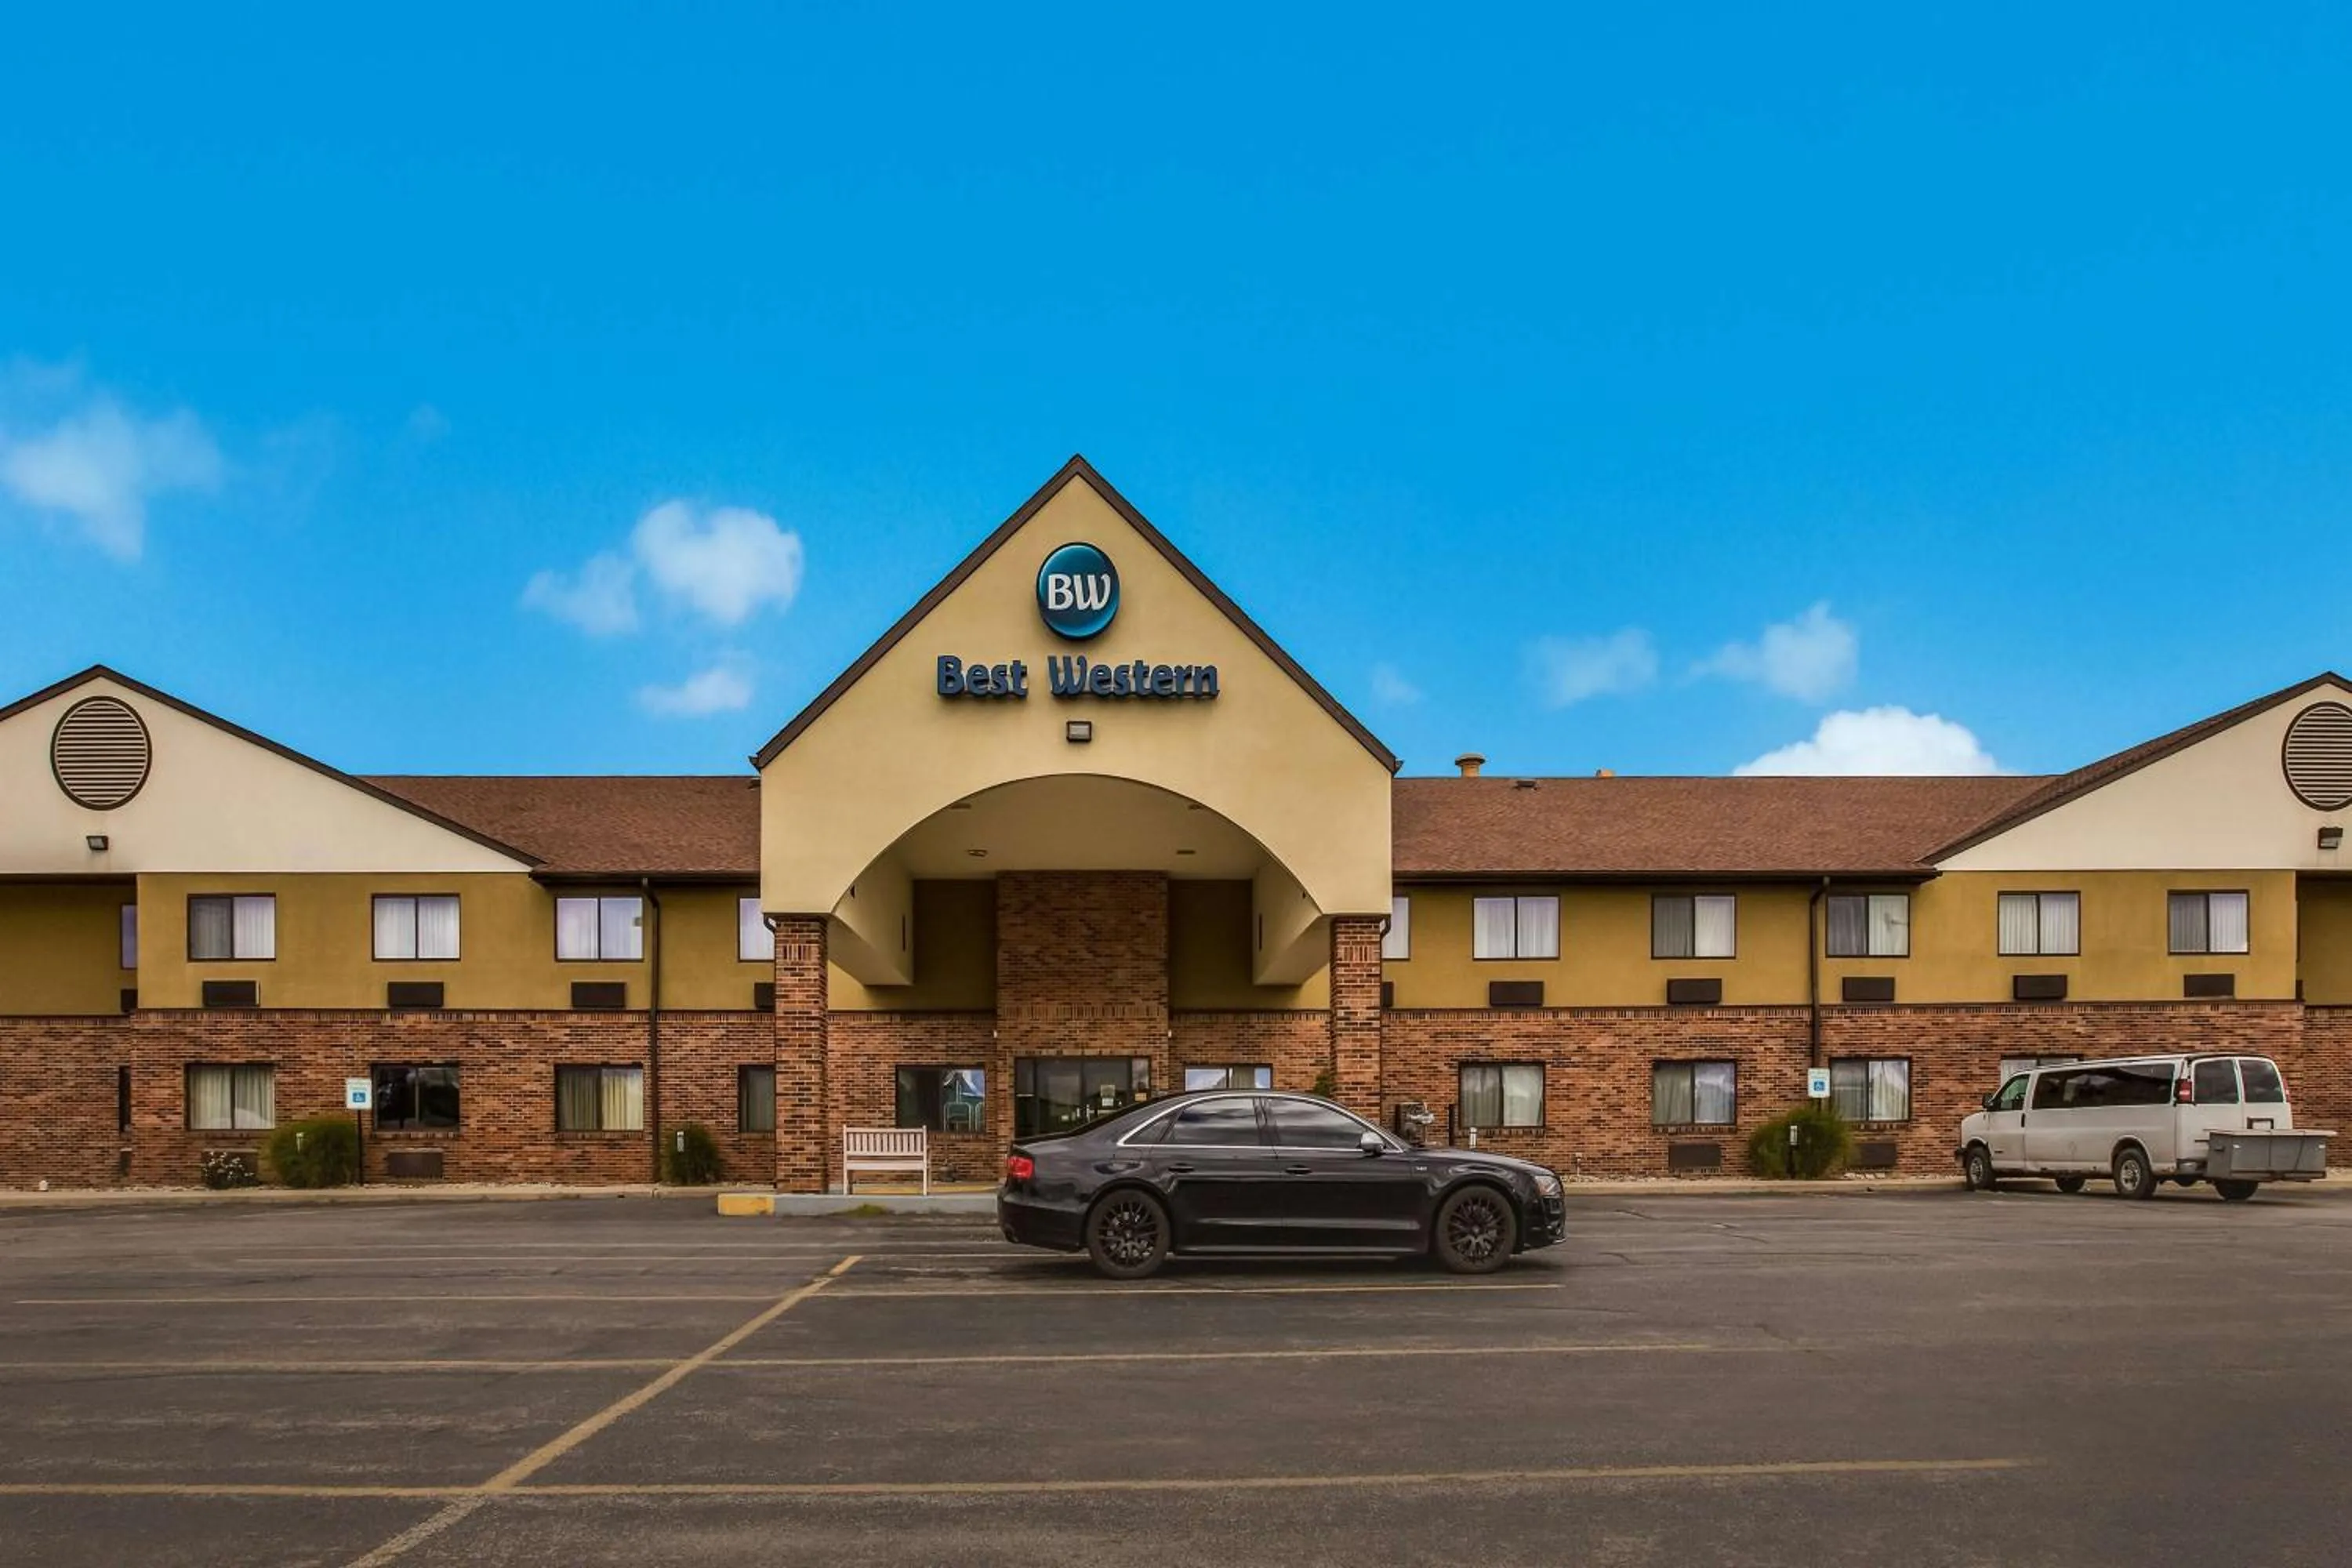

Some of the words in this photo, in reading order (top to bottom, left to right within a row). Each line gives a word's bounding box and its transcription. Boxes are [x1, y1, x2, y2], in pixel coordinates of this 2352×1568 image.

[1047, 573, 1111, 611] BW
[938, 655, 1028, 696] Best
[1047, 655, 1218, 697] Western
